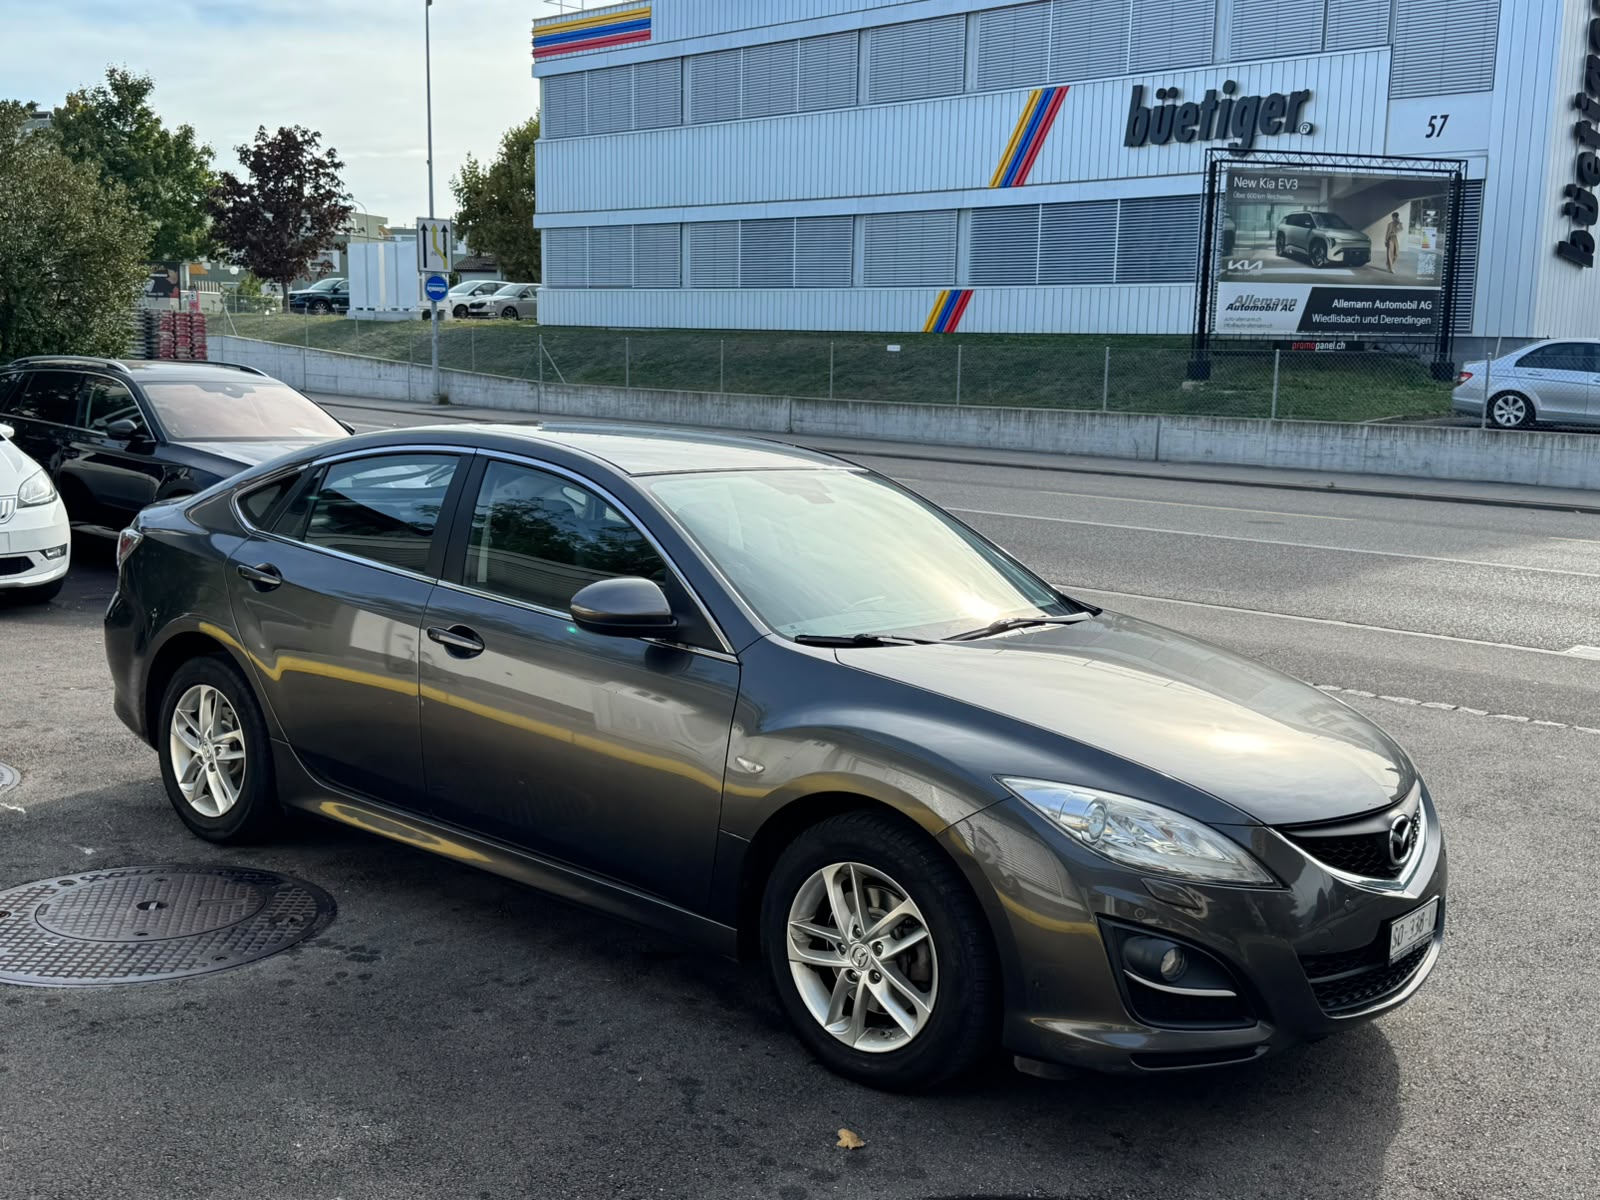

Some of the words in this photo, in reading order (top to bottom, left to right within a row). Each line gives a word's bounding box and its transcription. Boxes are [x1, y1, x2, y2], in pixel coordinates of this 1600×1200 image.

[1425, 113, 1450, 138] 57
[1233, 176, 1257, 189] New
[1259, 177, 1275, 190] Kia
[1278, 178, 1299, 191] EV3
[1232, 294, 1298, 307] Allemann
[1332, 299, 1373, 309] Allemann
[1374, 300, 1418, 310] Automobil
[1419, 301, 1433, 310] AG
[1225, 303, 1279, 312] Automobil
[1280, 304, 1296, 312] AG
[1312, 313, 1361, 324] Wiedlisbach
[1362, 314, 1378, 324] und
[1380, 315, 1432, 327] Derendingen
[1291, 341, 1347, 352] promopanel.ch
